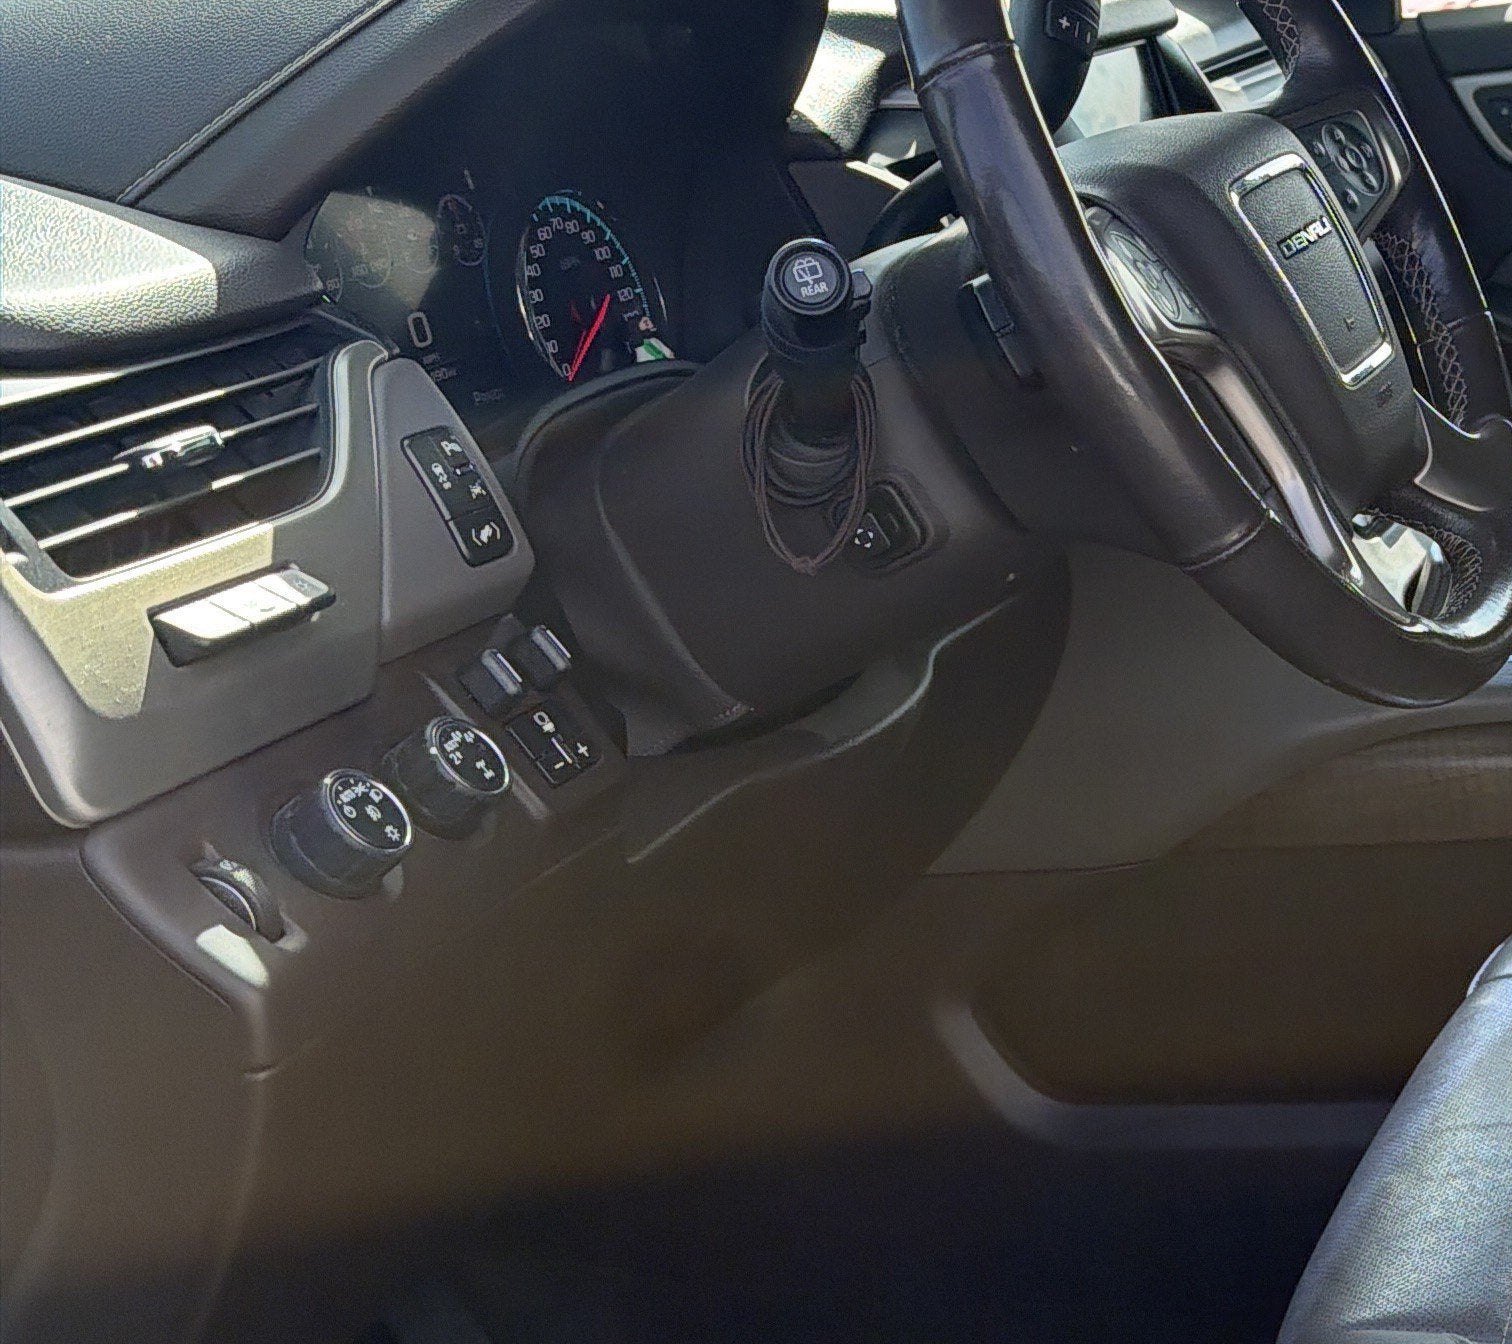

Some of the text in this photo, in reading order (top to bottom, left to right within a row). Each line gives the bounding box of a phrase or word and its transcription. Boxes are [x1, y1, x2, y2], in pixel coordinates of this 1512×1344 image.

[550, 216, 564, 231] 70
[565, 219, 579, 235] 80
[537, 225, 552, 241] 60
[581, 229, 595, 244] 90
[1279, 215, 1333, 258] DENALI
[529, 243, 545, 258] 50
[594, 245, 611, 262] 100
[526, 262, 541, 277] 40
[608, 264, 624, 279] 110
[528, 288, 544, 303] 30
[617, 286, 634, 302] 120
[800, 281, 829, 298] REAR
[535, 313, 550, 329] 20
[407, 311, 433, 348] 0
[562, 362, 572, 377] 0
